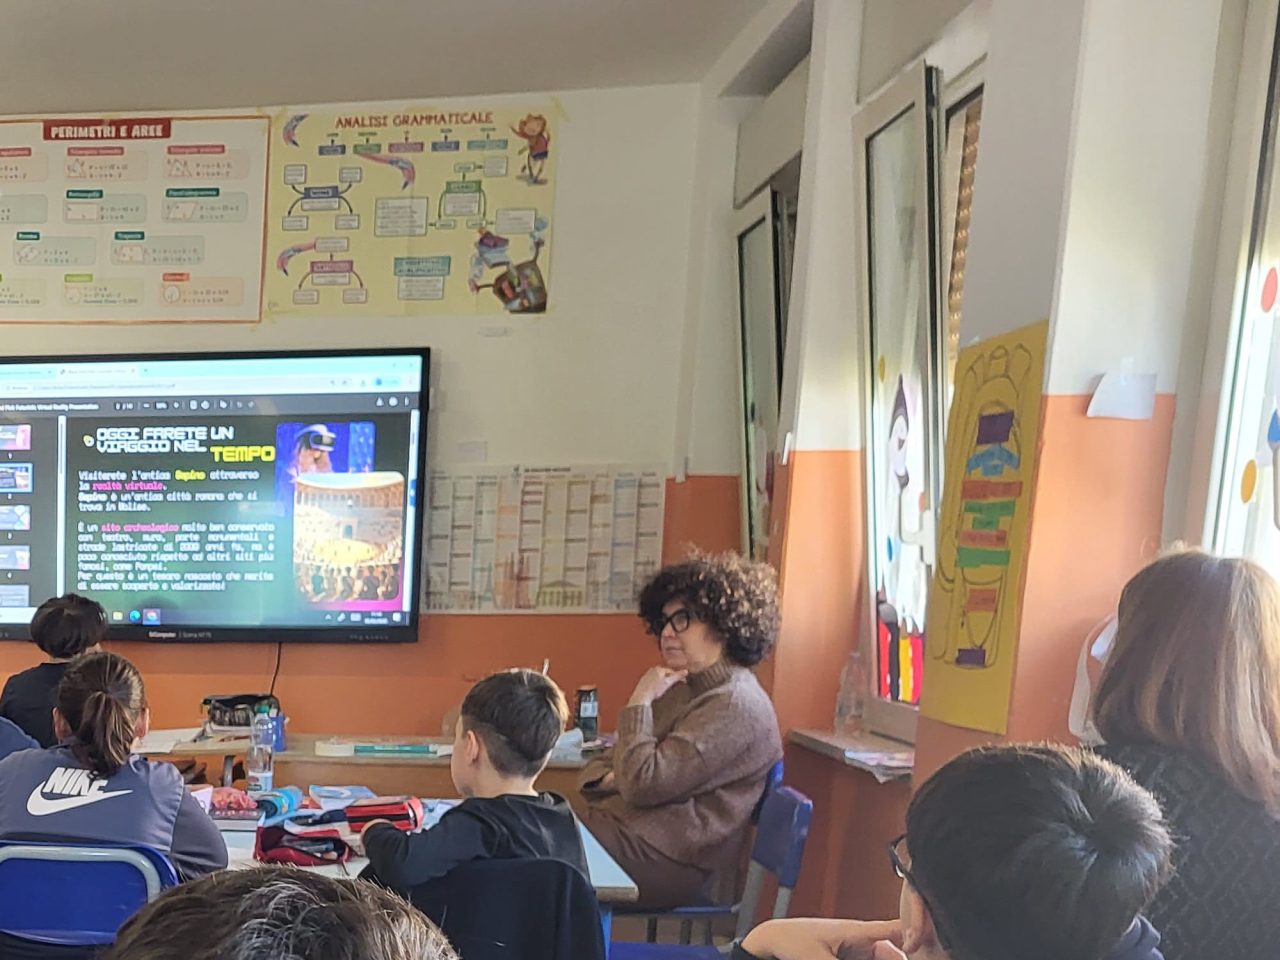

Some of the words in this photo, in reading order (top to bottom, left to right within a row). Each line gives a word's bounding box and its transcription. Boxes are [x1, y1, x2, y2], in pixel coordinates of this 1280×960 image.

[335, 115, 388, 129] ANALISI
[393, 112, 493, 126] GRAMMATICALE
[51, 125, 116, 138] PERIMETRI
[120, 125, 128, 137] E
[131, 124, 164, 137] AREE
[96, 428, 140, 441] OGGI
[143, 427, 207, 440] FARETE
[211, 426, 234, 440] UN
[97, 440, 170, 453] VIAGGIO
[174, 440, 207, 452] NEL
[210, 446, 276, 462] TEMPO
[42, 767, 108, 795] NIKE
